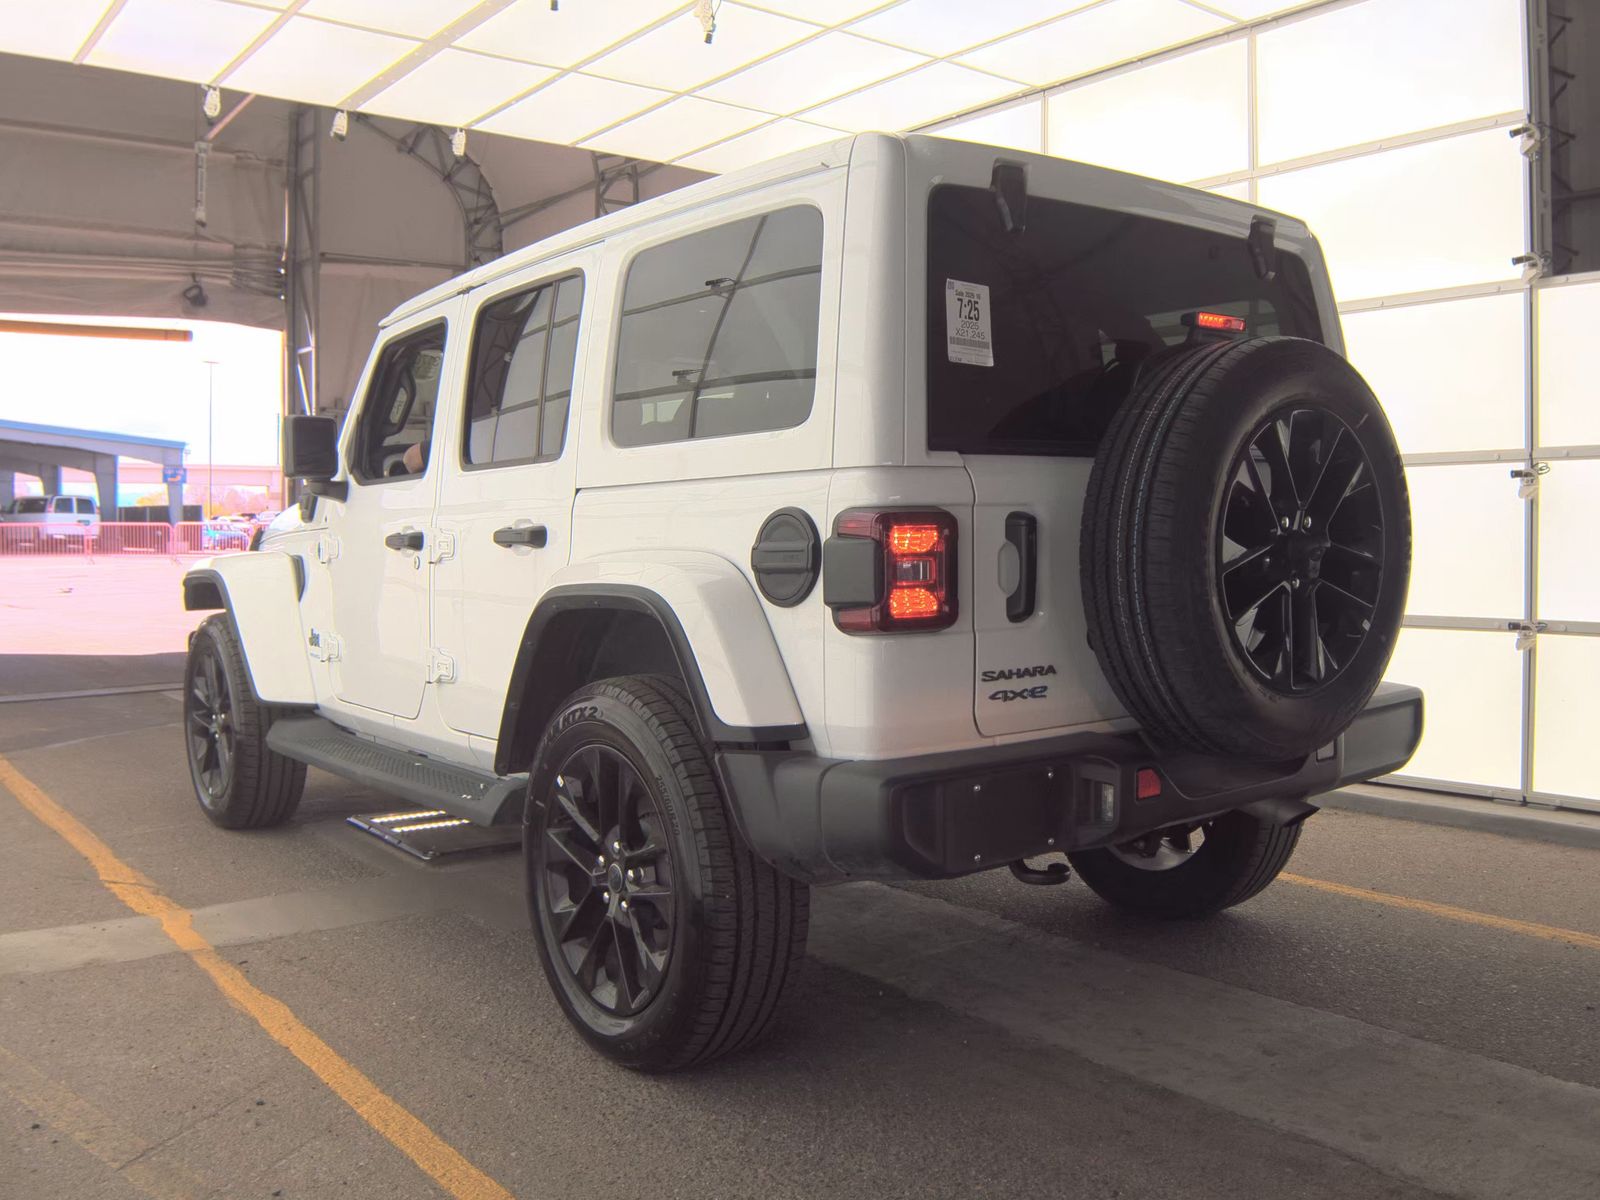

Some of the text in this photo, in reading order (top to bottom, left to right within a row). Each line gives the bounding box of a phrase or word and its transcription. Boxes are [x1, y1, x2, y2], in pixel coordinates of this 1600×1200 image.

[957, 298, 980, 321] 7:25
[961, 320, 979, 330] 2025
[981, 665, 1057, 682] SAHARA
[988, 685, 1048, 702] 4xe
